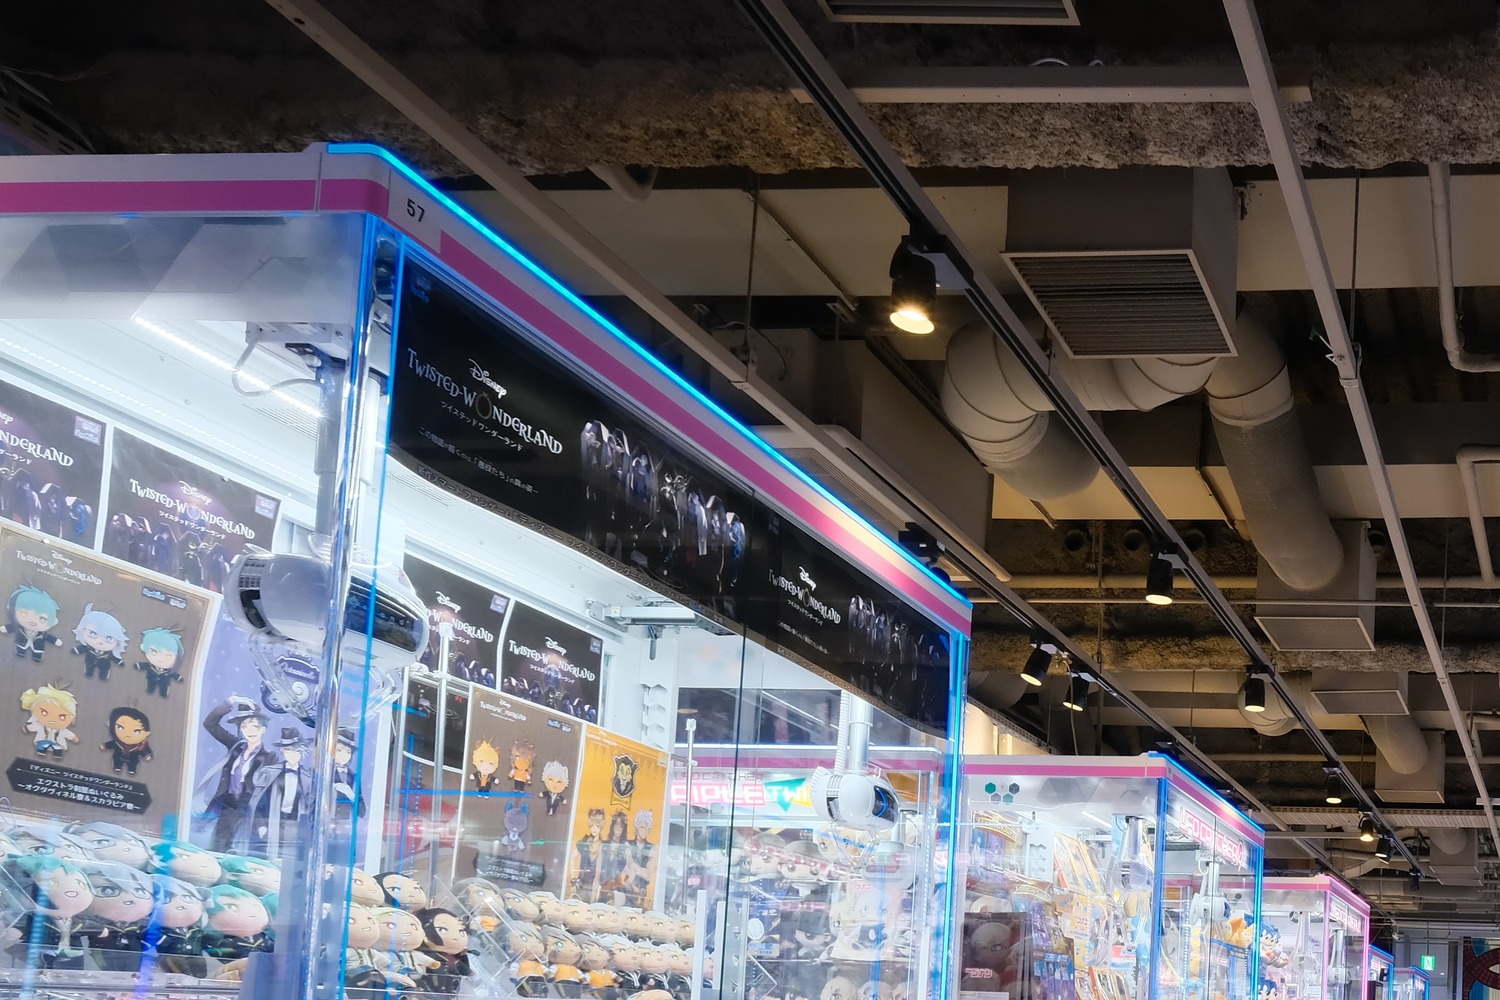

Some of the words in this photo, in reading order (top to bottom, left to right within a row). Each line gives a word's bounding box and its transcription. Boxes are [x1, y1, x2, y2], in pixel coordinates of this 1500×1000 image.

[406, 198, 426, 224] 57
[467, 358, 508, 399] Disney
[178, 480, 213, 506] Disney
